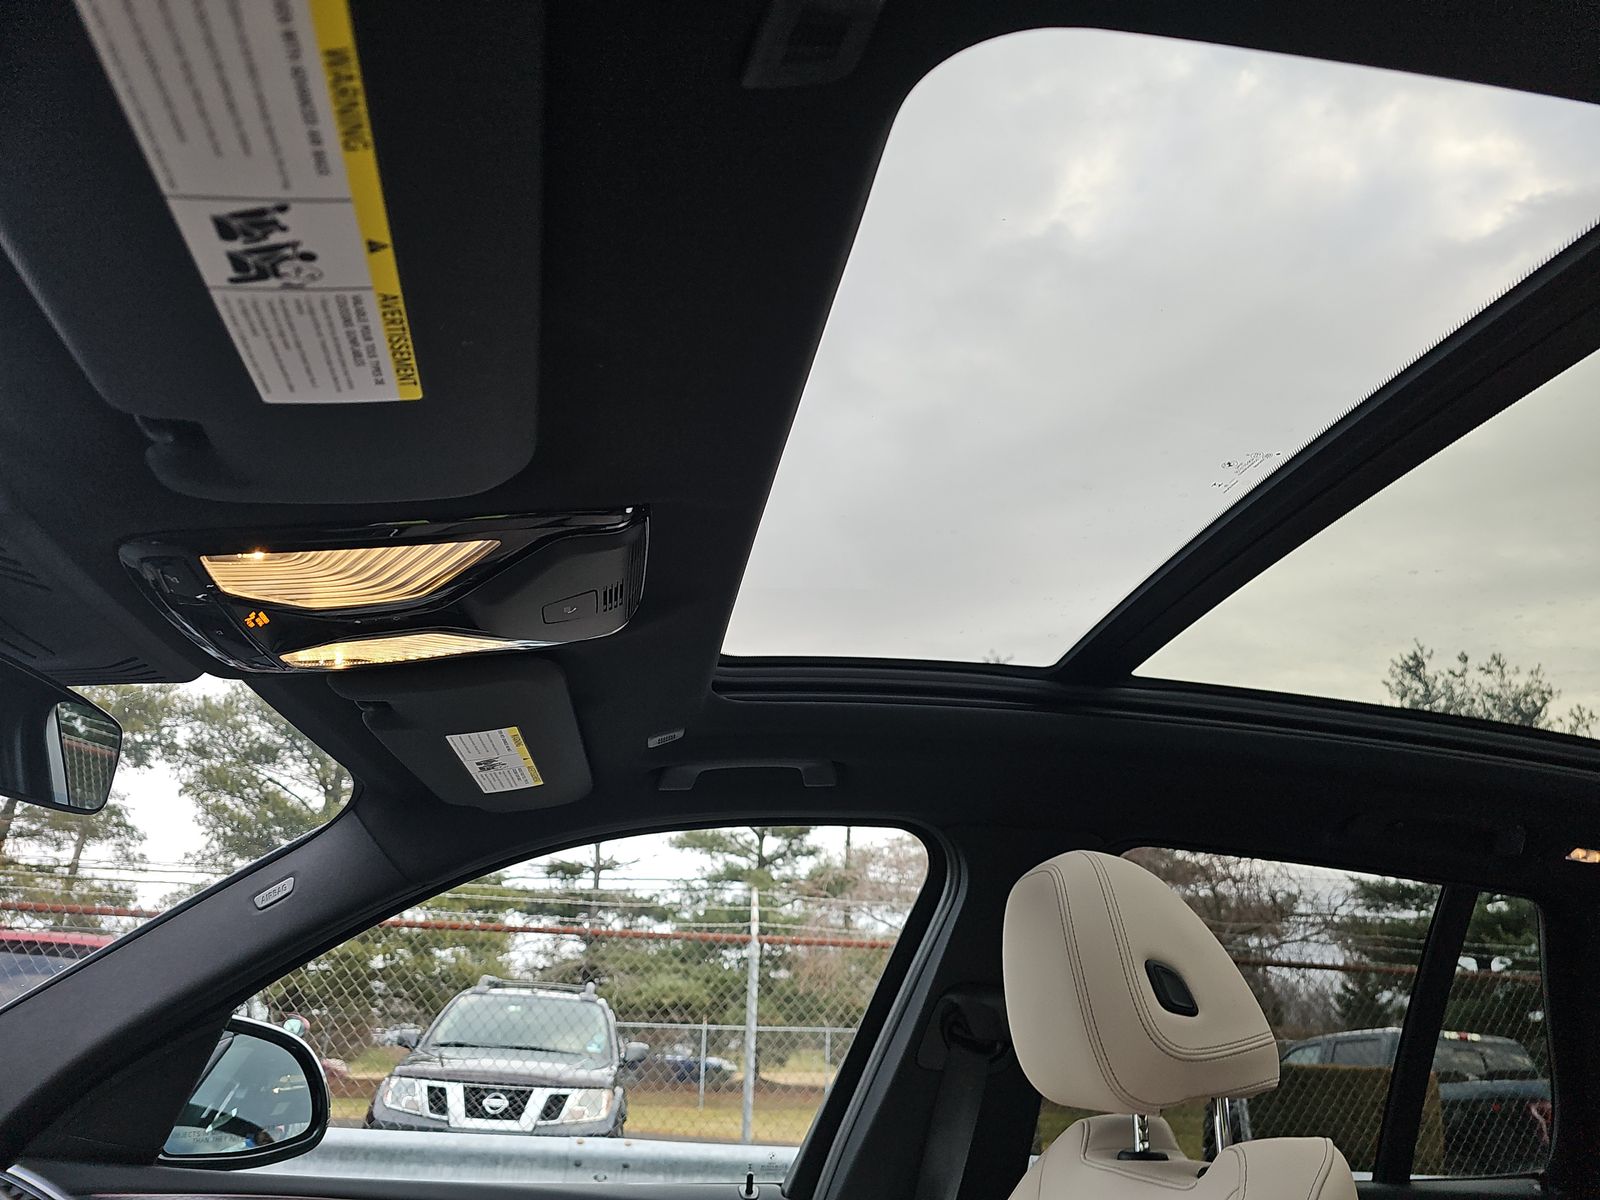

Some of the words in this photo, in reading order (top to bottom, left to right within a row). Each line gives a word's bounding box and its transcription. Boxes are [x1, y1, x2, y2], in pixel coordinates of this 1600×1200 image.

[323, 48, 372, 152] WARNING
[378, 293, 417, 387] AVERTISSEMENT
[260, 883, 288, 905] AIRBAG
